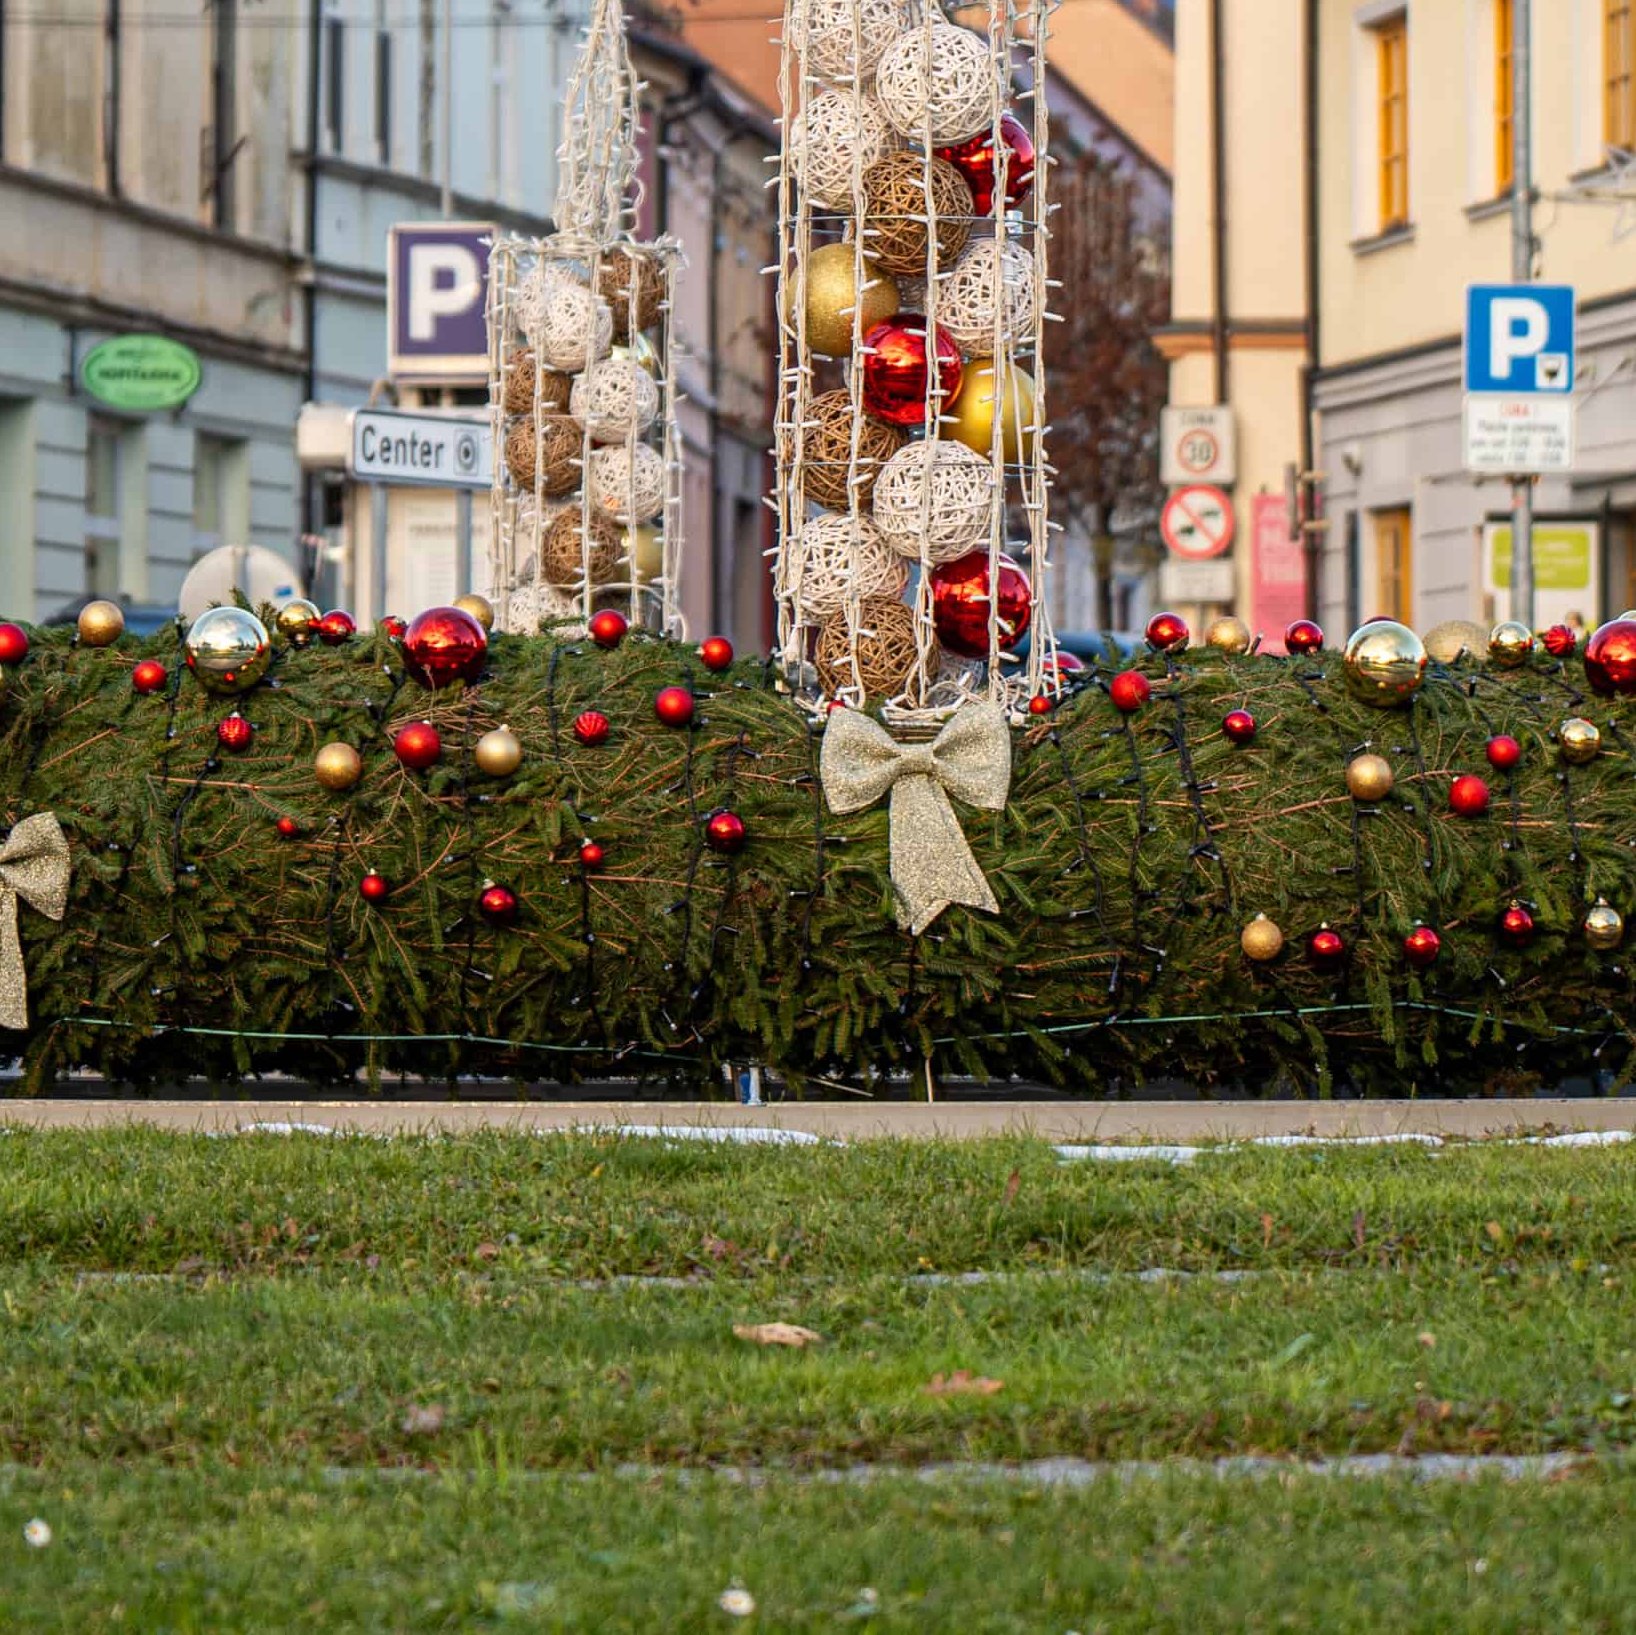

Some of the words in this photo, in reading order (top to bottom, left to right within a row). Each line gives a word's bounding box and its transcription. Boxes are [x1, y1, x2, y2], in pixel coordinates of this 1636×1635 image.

[408, 242, 482, 342] P
[1489, 296, 1550, 380] P
[361, 424, 445, 469] Center
[1187, 440, 1211, 458] 30
